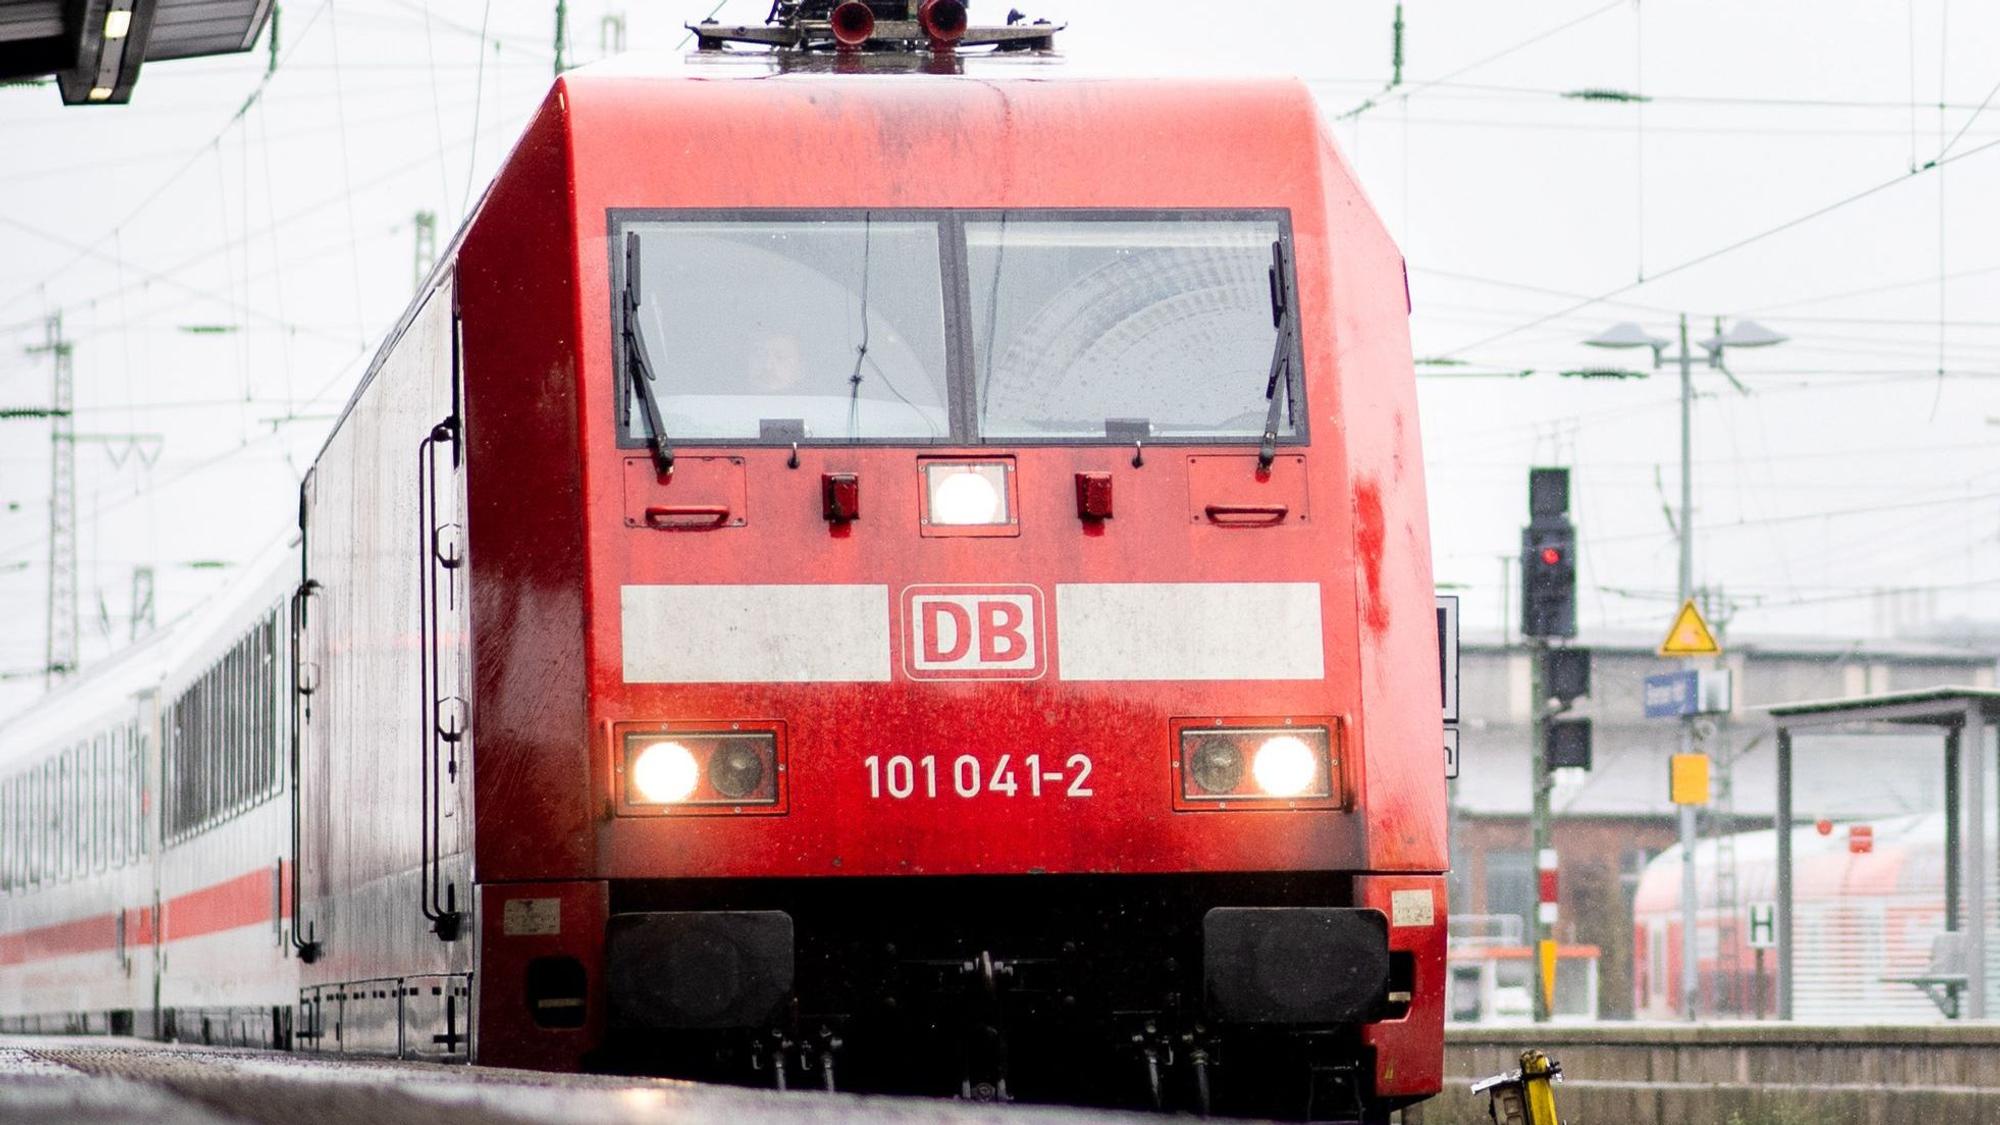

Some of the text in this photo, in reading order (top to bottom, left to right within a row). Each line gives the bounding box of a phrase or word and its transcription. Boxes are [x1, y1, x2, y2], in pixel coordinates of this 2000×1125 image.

[921, 601, 1028, 662] DB
[864, 753, 1093, 798] 101 041-2
[1751, 905, 1774, 943] H
